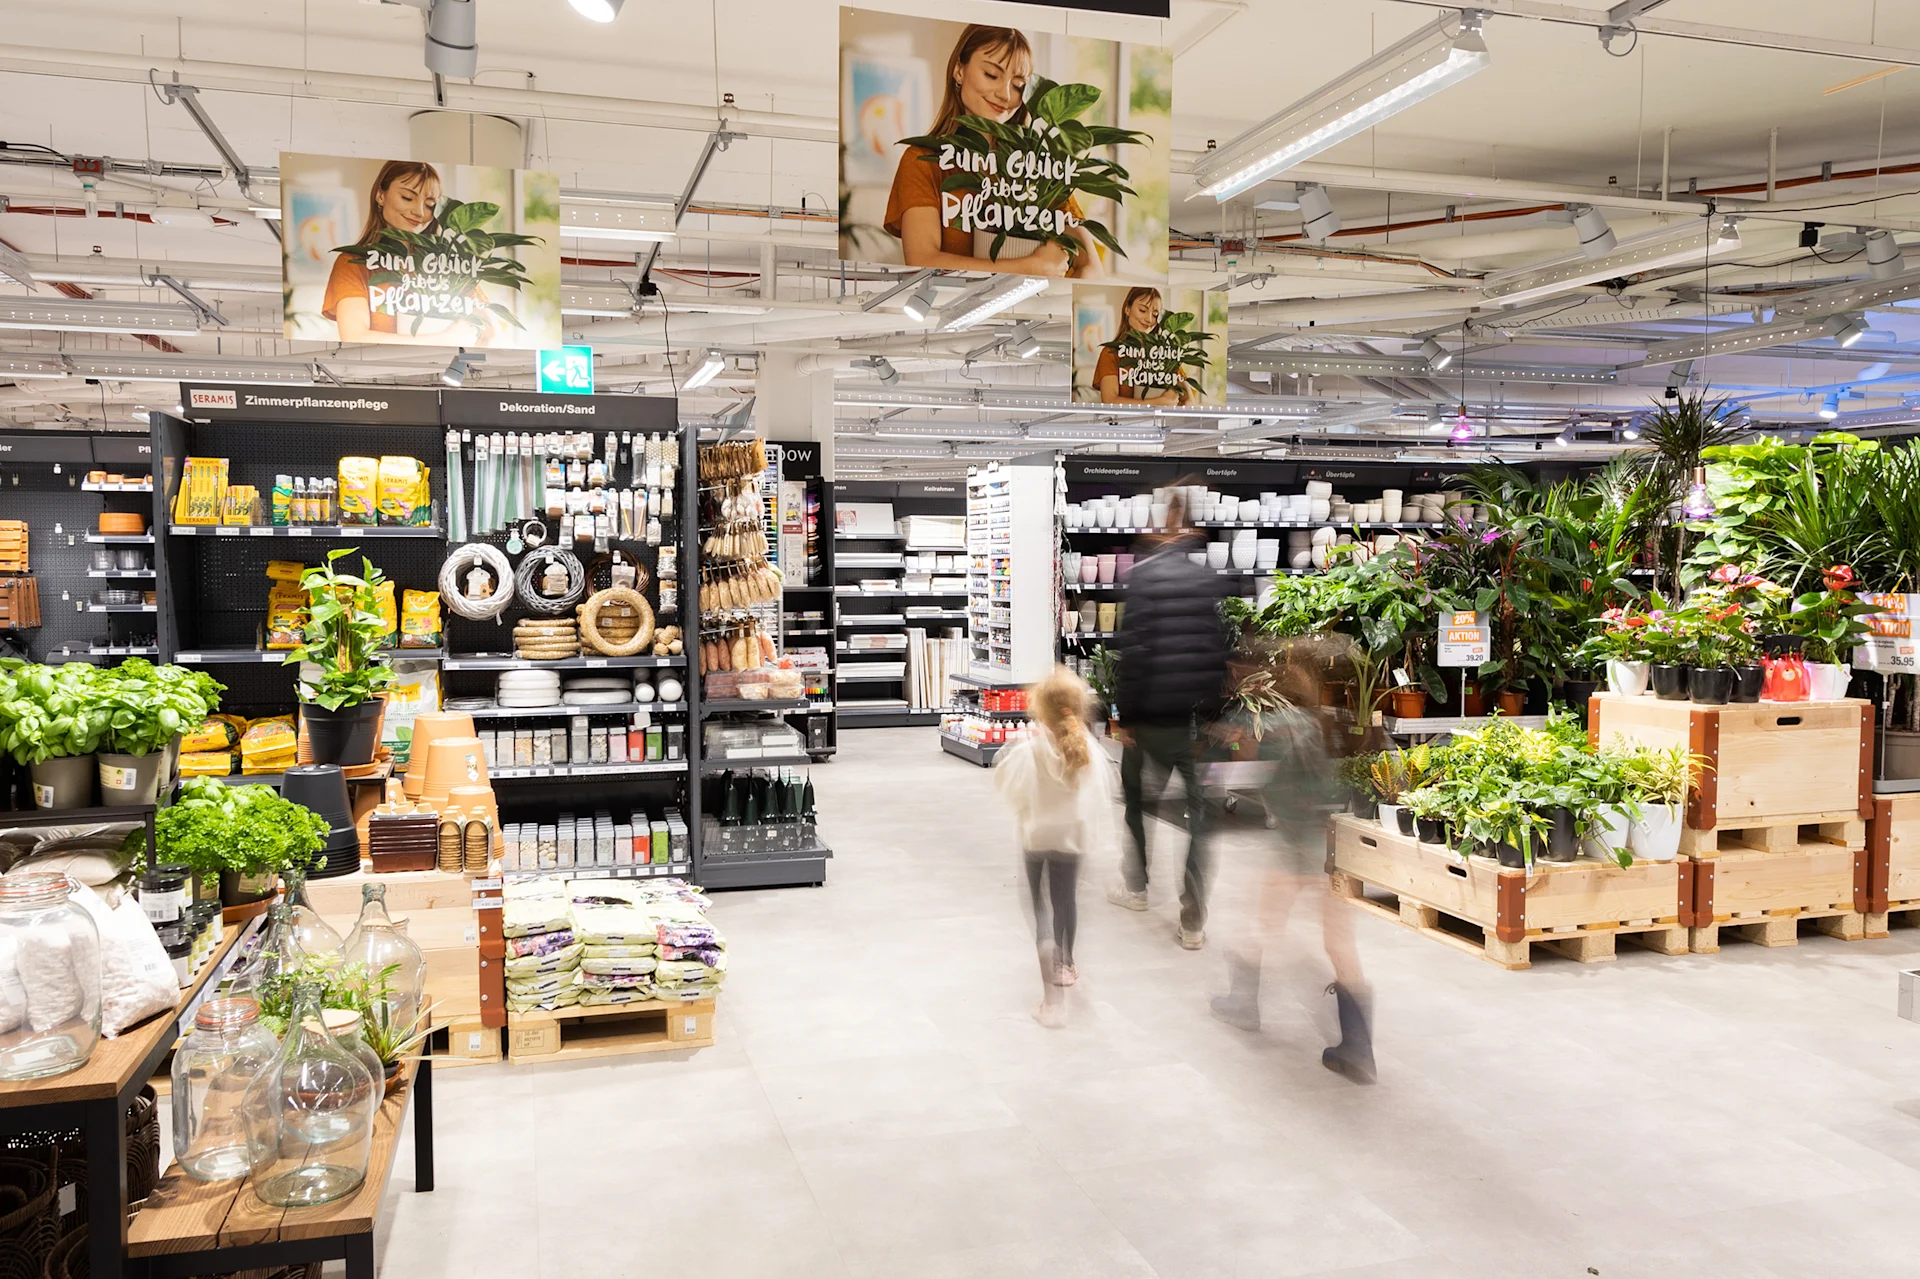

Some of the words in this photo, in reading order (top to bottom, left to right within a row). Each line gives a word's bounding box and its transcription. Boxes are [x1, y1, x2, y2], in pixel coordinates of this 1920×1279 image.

[939, 143, 998, 175] Zum
[1006, 149, 1080, 185] Glück
[981, 176, 1038, 202] gibt's
[941, 191, 1079, 236] Pflanzen
[366, 250, 415, 272] Zum
[422, 252, 485, 278] Glück
[368, 285, 486, 317] Pflanzen
[1117, 344, 1146, 359] Zum
[1150, 345, 1185, 362] Glück
[1118, 367, 1185, 387] Pflanzen
[193, 394, 234, 405] SERAMIS
[244, 395, 389, 411] Zimmerpflanzenpflege
[499, 402, 596, 415] Dekoration/Sand
[1083, 466, 1140, 476] Orchideengefässe
[1206, 468, 1238, 477] Übertöpfe
[1325, 470, 1356, 479] Übertöpfe
[923, 485, 955, 493] Keilrahmen
[1455, 613, 1474, 624] 20%
[1869, 621, 1909, 635] AKTION
[1449, 631, 1480, 641] AKTION
[1890, 656, 1914, 667] 35.95
